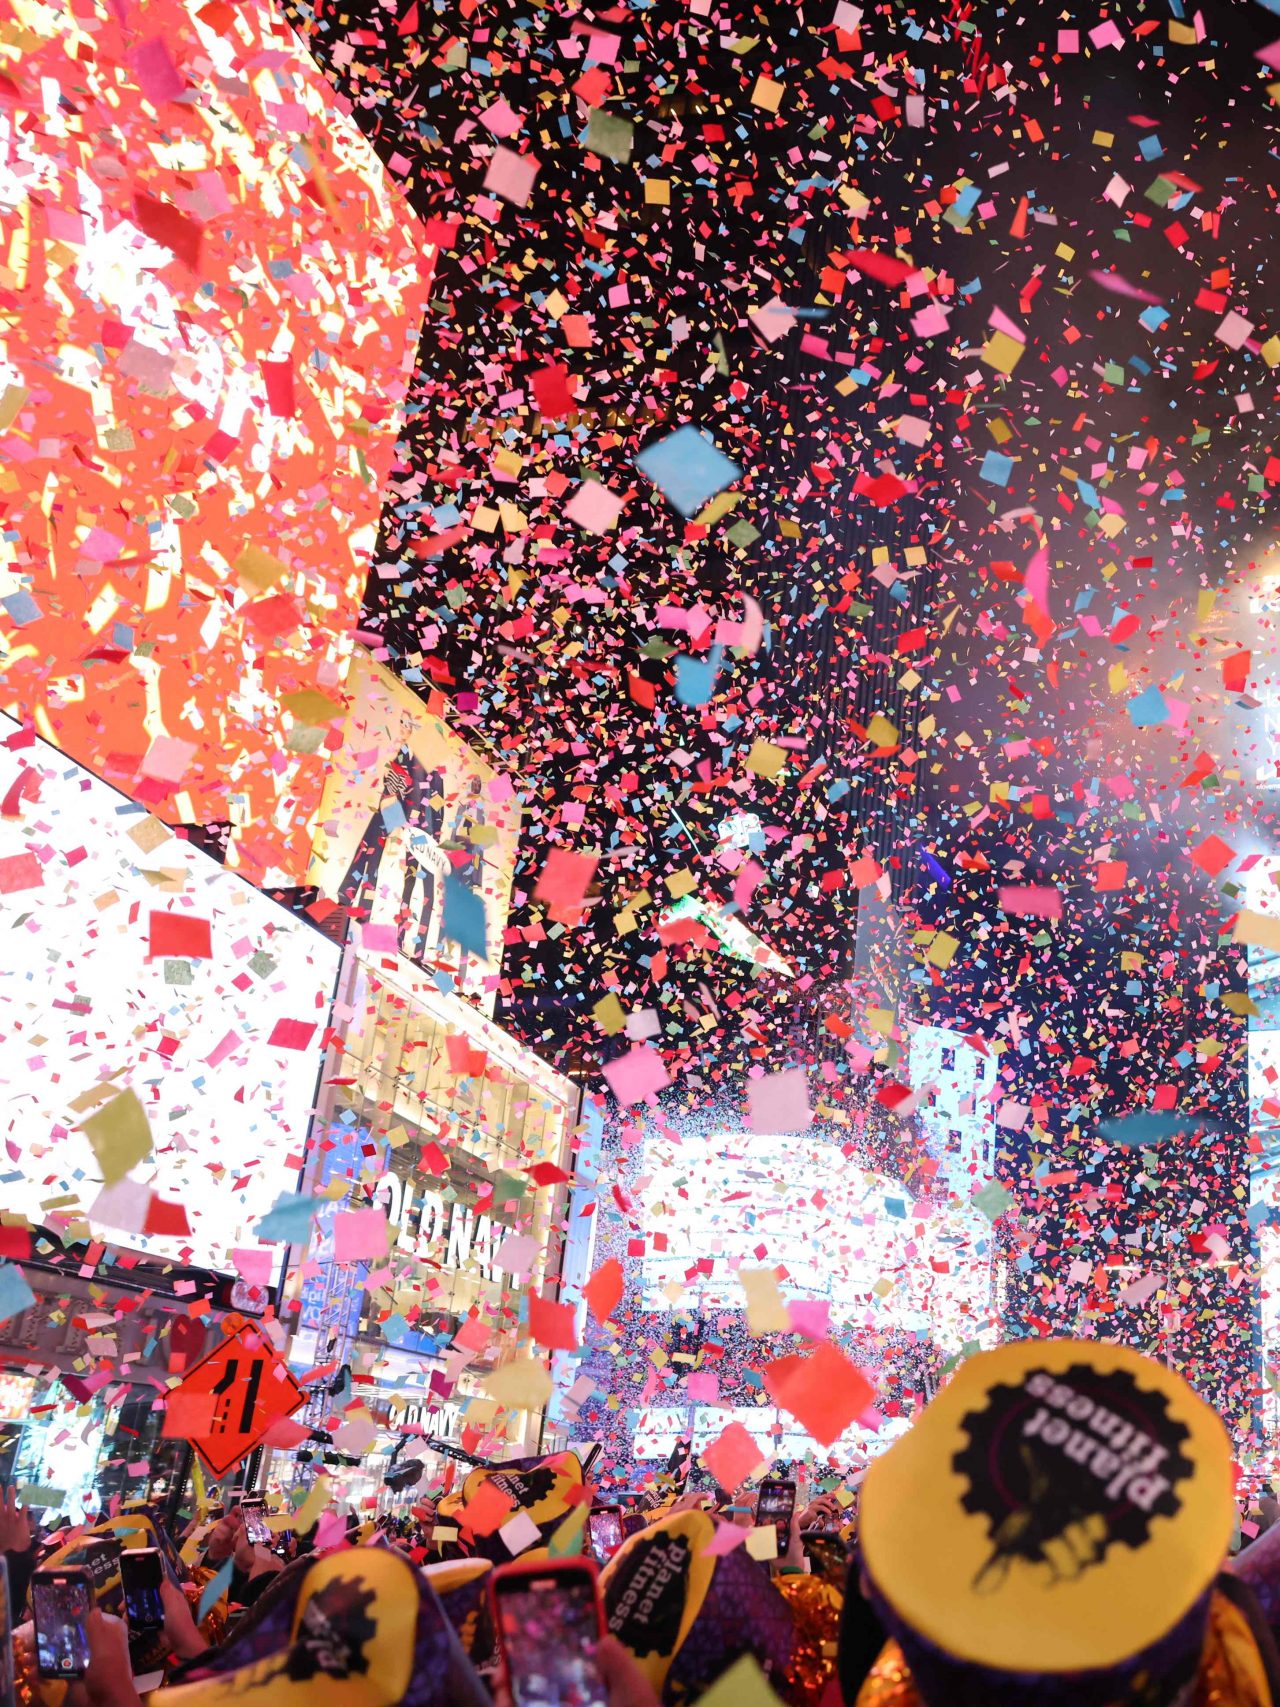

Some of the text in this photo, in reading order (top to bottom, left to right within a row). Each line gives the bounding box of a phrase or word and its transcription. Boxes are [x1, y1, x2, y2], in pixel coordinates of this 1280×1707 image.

[1023, 1408, 1170, 1512] planet
[1024, 1373, 1170, 1475] fitness
[608, 1545, 668, 1632] fitness
[633, 1541, 687, 1625] planet
